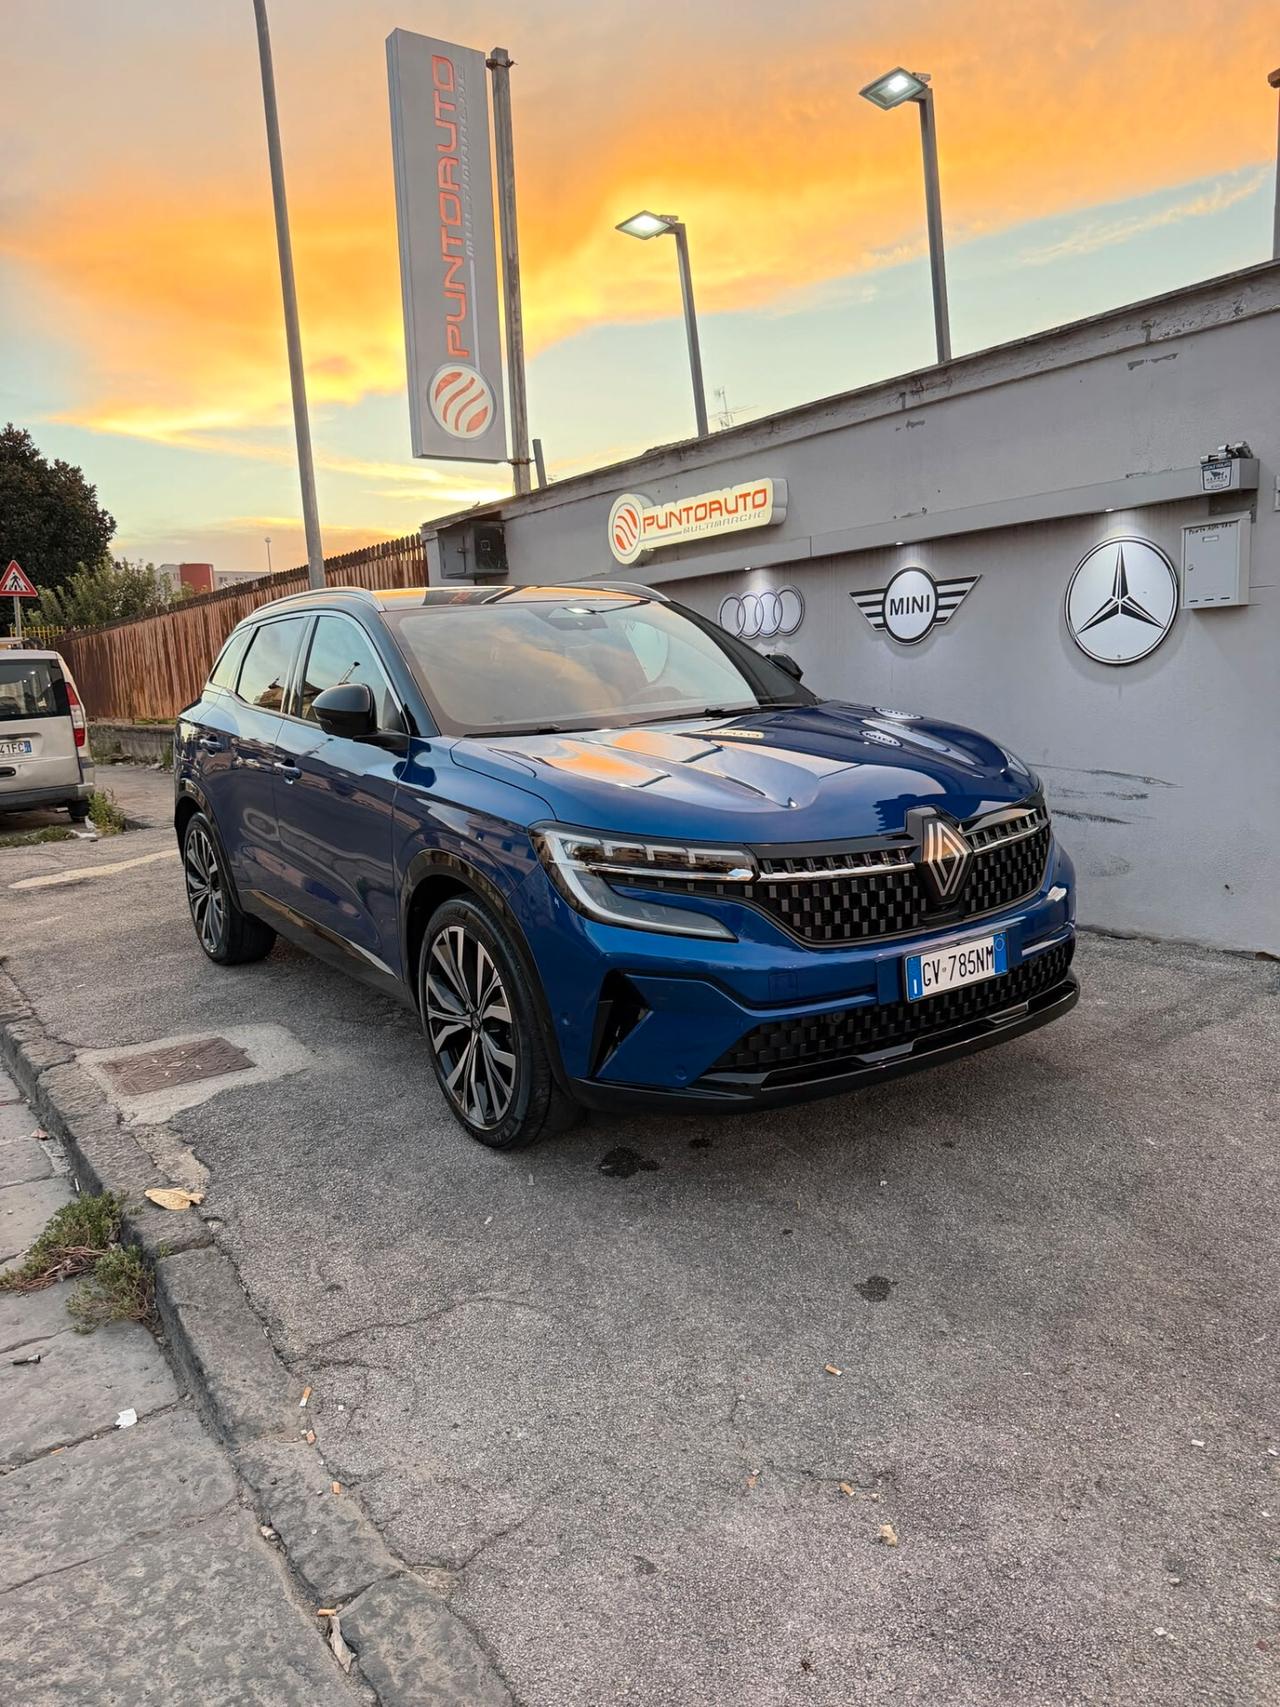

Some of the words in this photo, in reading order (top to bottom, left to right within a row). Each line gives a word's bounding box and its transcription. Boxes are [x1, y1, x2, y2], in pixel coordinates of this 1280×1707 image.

[432, 54, 470, 358] PUNTOAUTO
[642, 488, 767, 534] PUNTOAUTO
[682, 510, 765, 535] MULTIMARCHE
[890, 594, 930, 616] MINI
[922, 958, 940, 987] GV
[948, 944, 994, 982] 785NM
